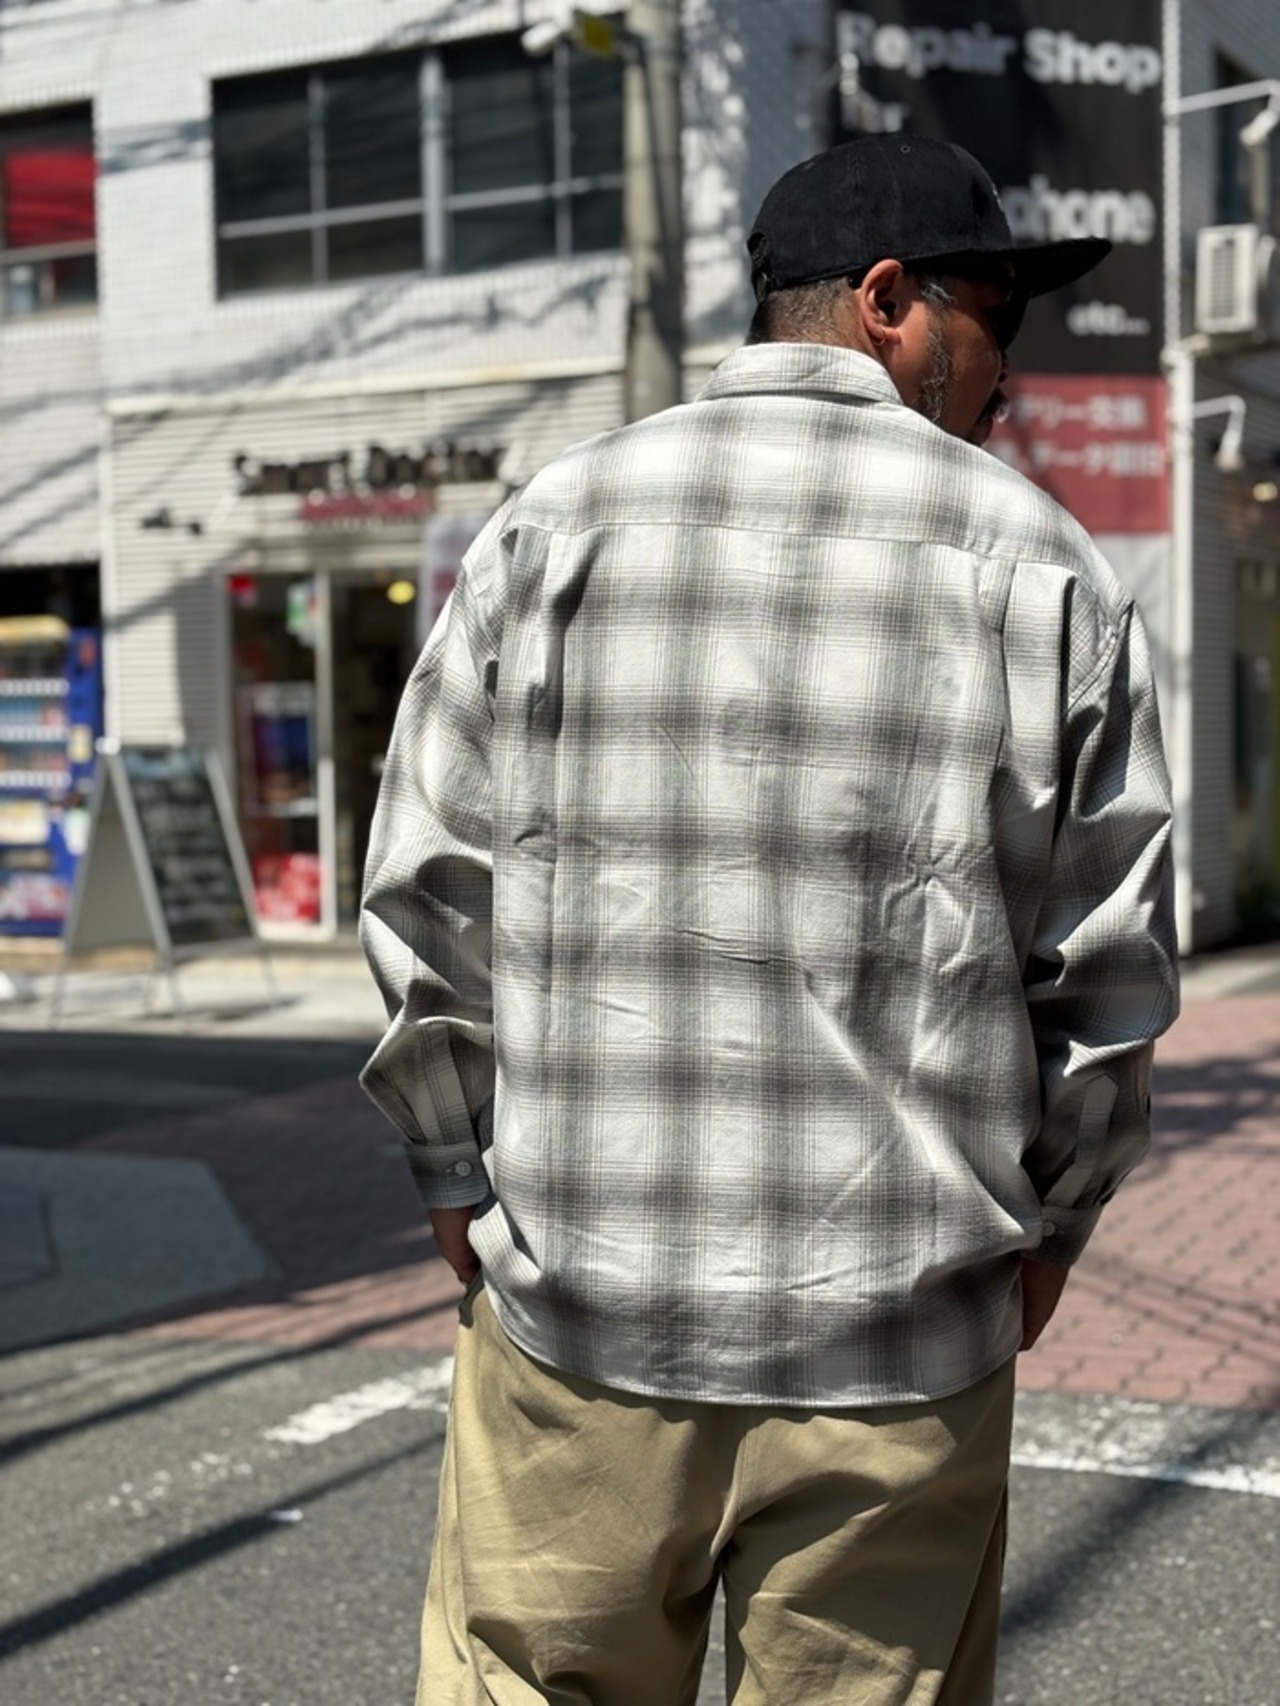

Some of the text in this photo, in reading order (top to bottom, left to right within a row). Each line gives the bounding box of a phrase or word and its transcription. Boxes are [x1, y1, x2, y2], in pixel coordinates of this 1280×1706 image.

[836, 10, 1160, 94] Repair Shop
[1002, 173, 1156, 246] phone
